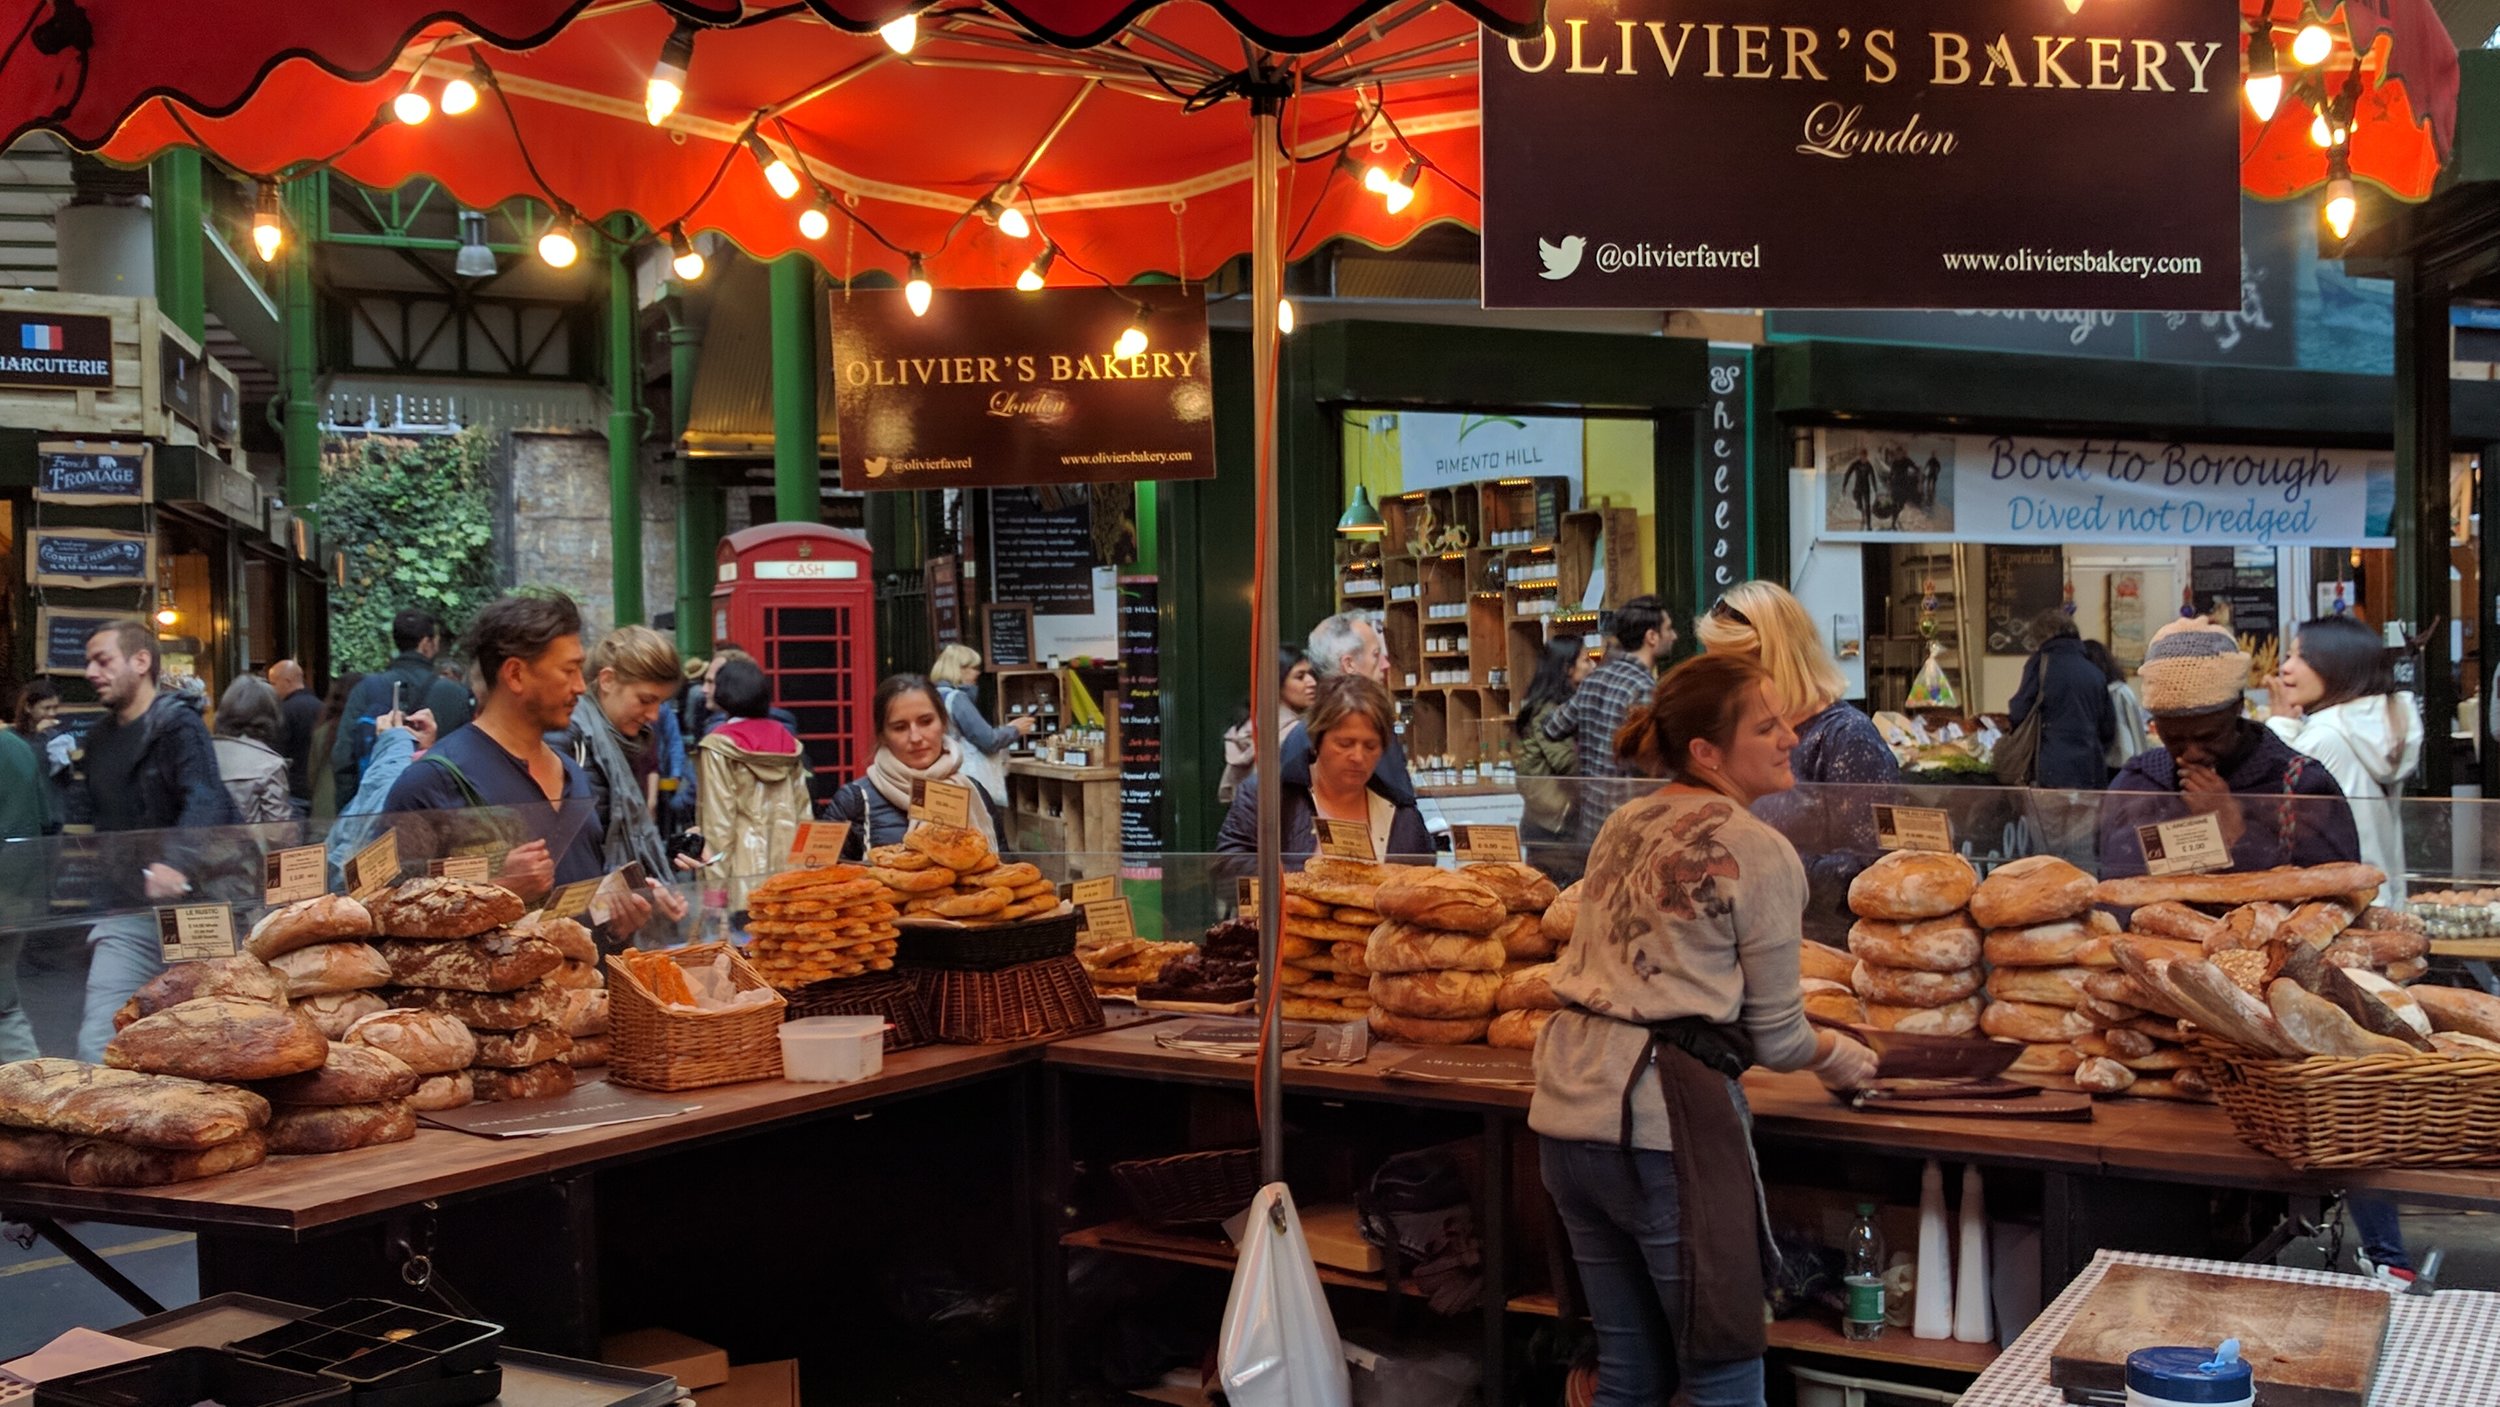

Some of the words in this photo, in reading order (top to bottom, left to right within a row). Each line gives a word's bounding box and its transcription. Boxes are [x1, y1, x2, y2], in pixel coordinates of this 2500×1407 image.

[1507, 19, 1898, 84] OLIVIER'S
[1929, 32, 2222, 93] BAKERY
[1795, 101, 1959, 158] London
[1596, 244, 1760, 273] @olivierfavrel
[1942, 248, 2203, 279] www.oliviersbakery.com
[846, 355, 1036, 386] OLIVIER'S
[1050, 352, 1198, 381] BAKERY
[987, 390, 1066, 417] London
[892, 457, 972, 473] @olivierfavrel
[1061, 451, 1192, 465] www.oliviersbakery.com
[1436, 452, 1500, 475] PIMENTO
[1506, 447, 1543, 467] HILL
[1989, 436, 2100, 481] Boat
[2107, 440, 2156, 482] to
[2162, 443, 2341, 502] Borough
[49, 468, 134, 490] FROMAGE
[2008, 495, 2110, 531] Dived
[2118, 500, 2176, 532] not
[2180, 498, 2318, 544] Dredged
[786, 564, 825, 577] CASH
[1134, 605, 1157, 613] HILL
